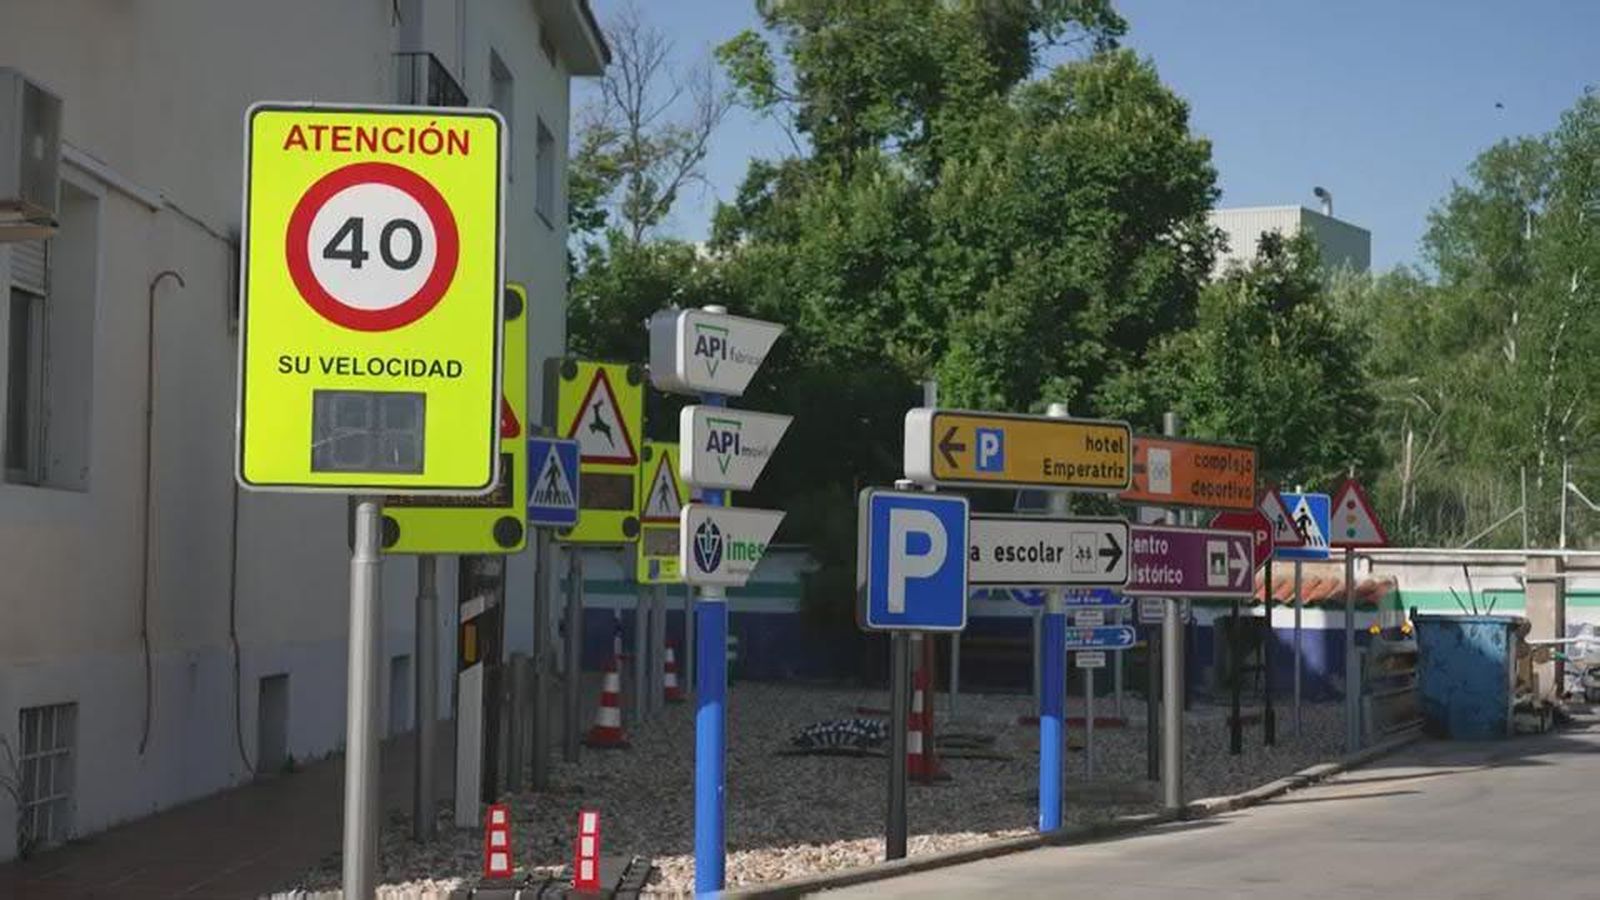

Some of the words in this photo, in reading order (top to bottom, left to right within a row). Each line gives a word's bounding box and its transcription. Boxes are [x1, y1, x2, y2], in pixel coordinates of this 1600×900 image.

[283, 121, 470, 156] ATENCIÓN
[323, 216, 423, 271] 40
[694, 334, 727, 361] API
[278, 355, 311, 375] SU
[320, 357, 463, 379] VELOCIDAD
[706, 430, 739, 456] API
[980, 433, 999, 468] P
[1086, 435, 1124, 454] hotel
[1043, 458, 1124, 480] Emperatriz
[994, 540, 1064, 563] escolar
[1133, 535, 1169, 555] entro
[887, 507, 948, 614] P
